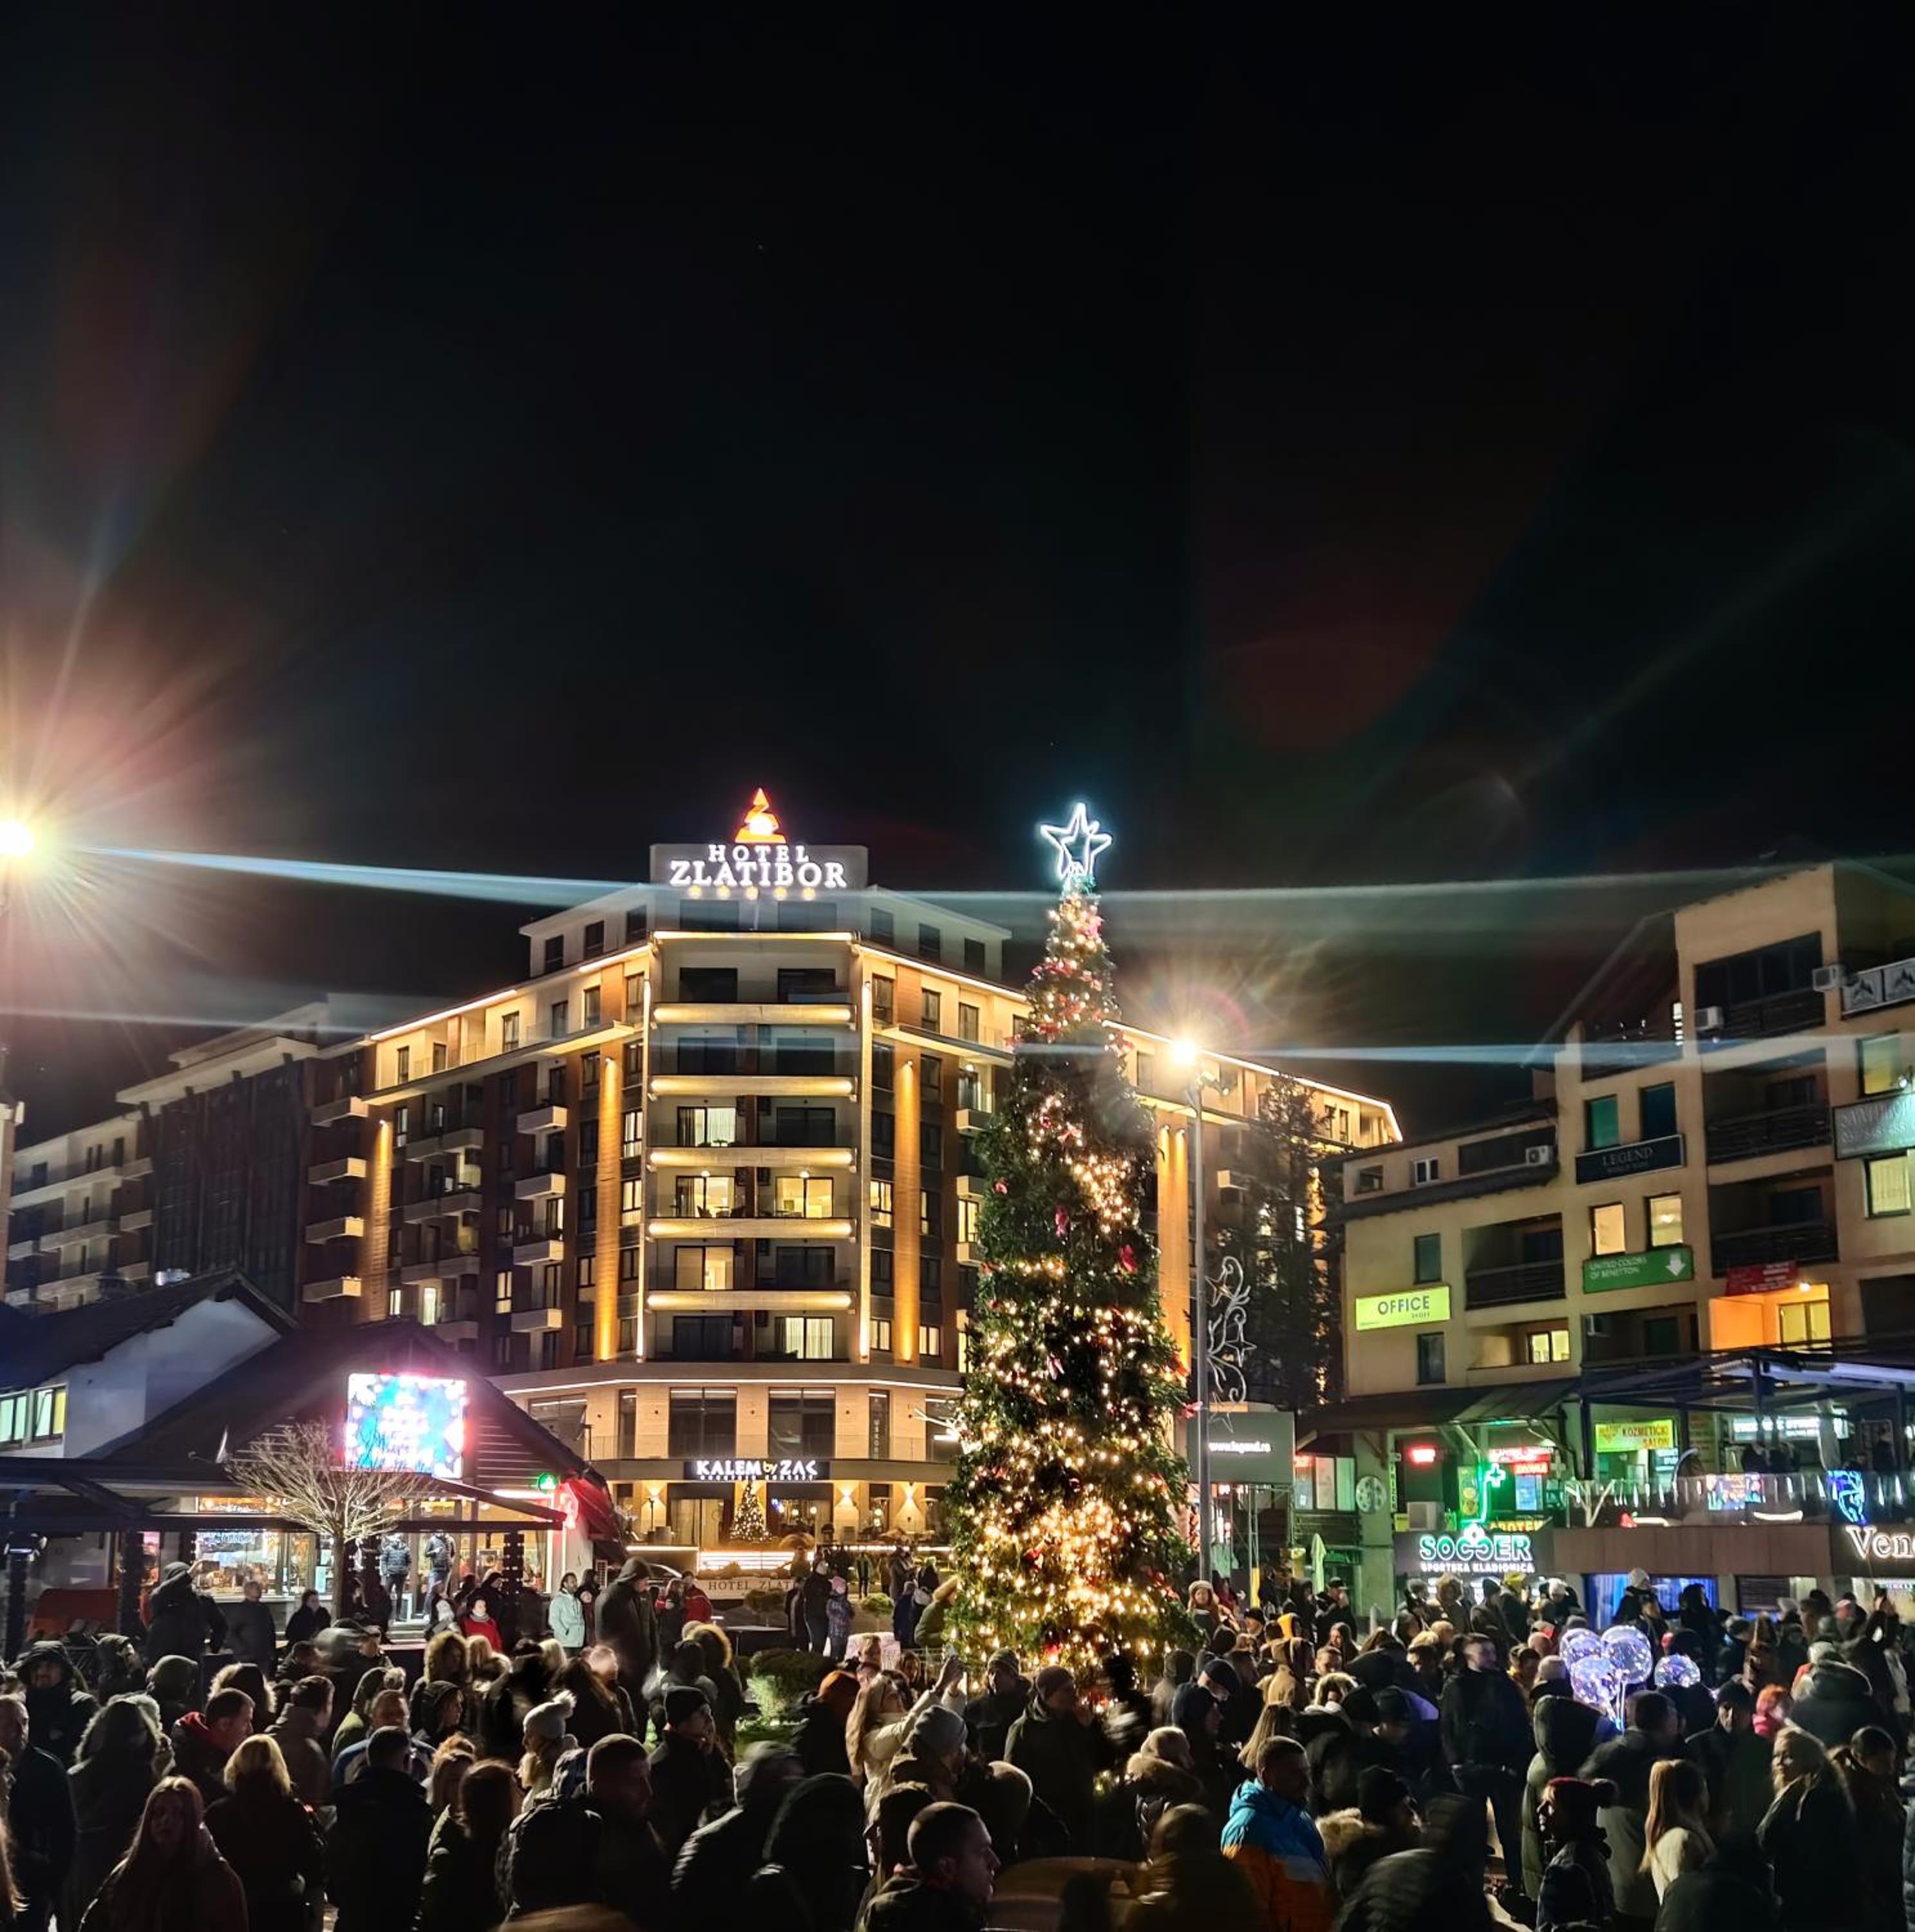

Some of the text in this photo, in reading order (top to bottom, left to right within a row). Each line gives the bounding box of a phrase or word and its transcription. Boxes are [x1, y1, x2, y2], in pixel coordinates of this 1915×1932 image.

[708, 844, 809, 862] HOTEL
[670, 860, 847, 887] ZLATIBOR
[1602, 1145, 1654, 1167] LEGEND
[1377, 1295, 1430, 1315] OFFICE
[696, 1460, 762, 1475] KALEM
[762, 1461, 778, 1475] by
[1419, 1534, 1533, 1562] SOCCER
[1845, 1525, 1915, 1559] Ven
[709, 1581, 791, 1590] HOTEL ZLAT
